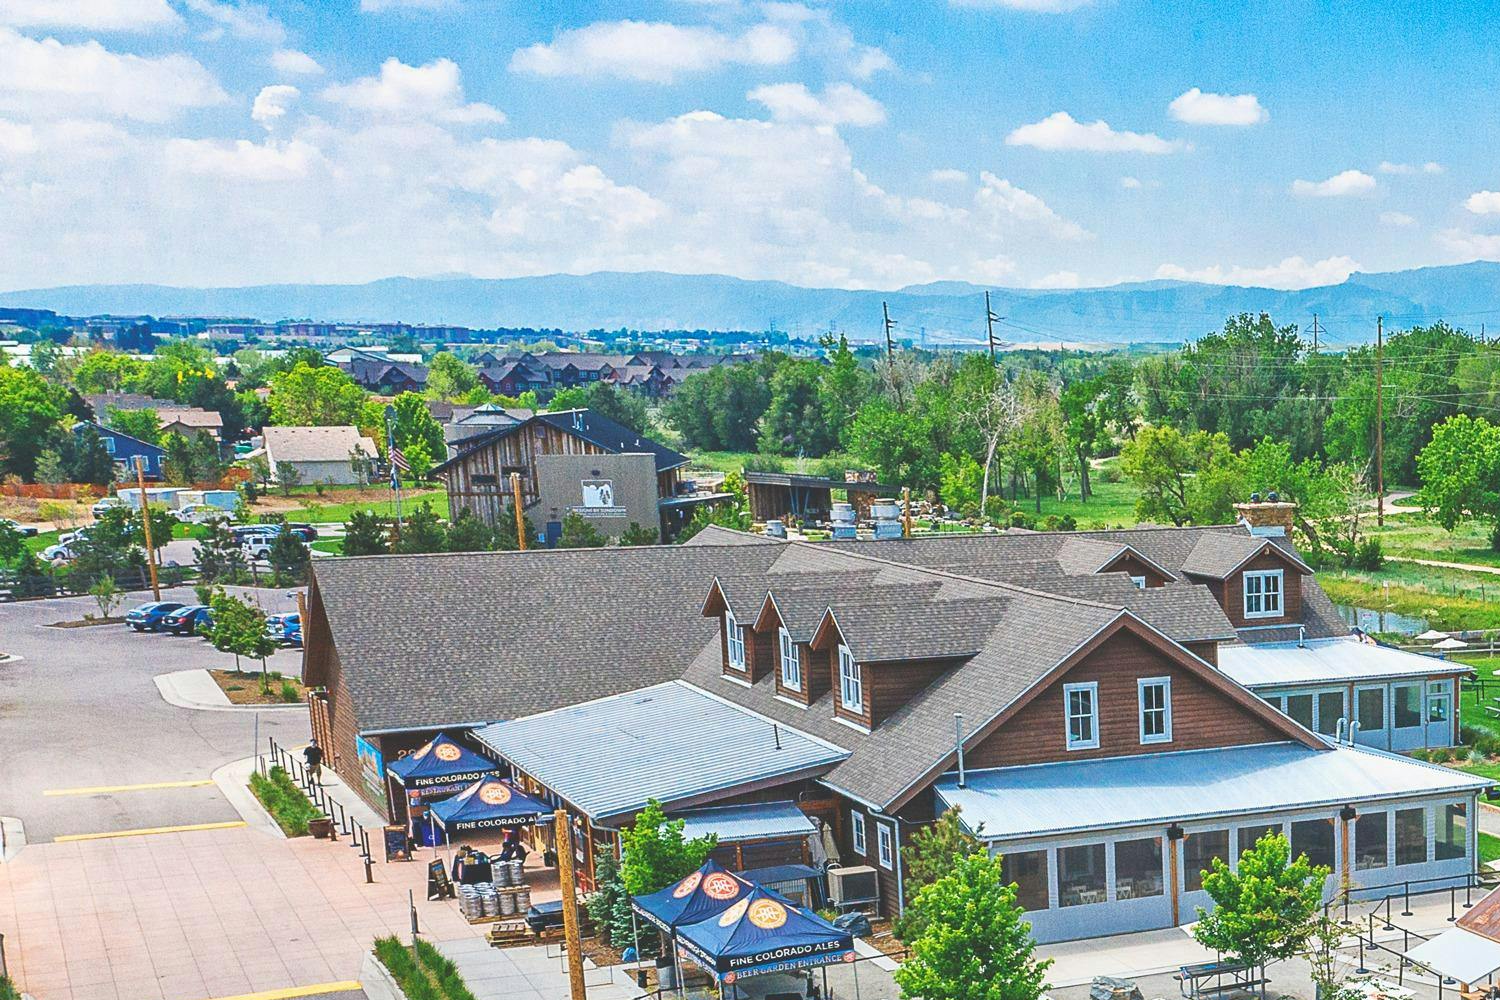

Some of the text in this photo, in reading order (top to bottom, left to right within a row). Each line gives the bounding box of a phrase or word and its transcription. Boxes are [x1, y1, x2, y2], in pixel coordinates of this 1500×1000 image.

[416, 777, 434, 786] FINE
[435, 773, 480, 784] COLORADO
[456, 821, 476, 830] FINE
[478, 817, 526, 828] COLORADO
[730, 940, 840, 967] FINE COLORADO ALES
[737, 955, 842, 979] BEER GARDEN ENTRANCE
